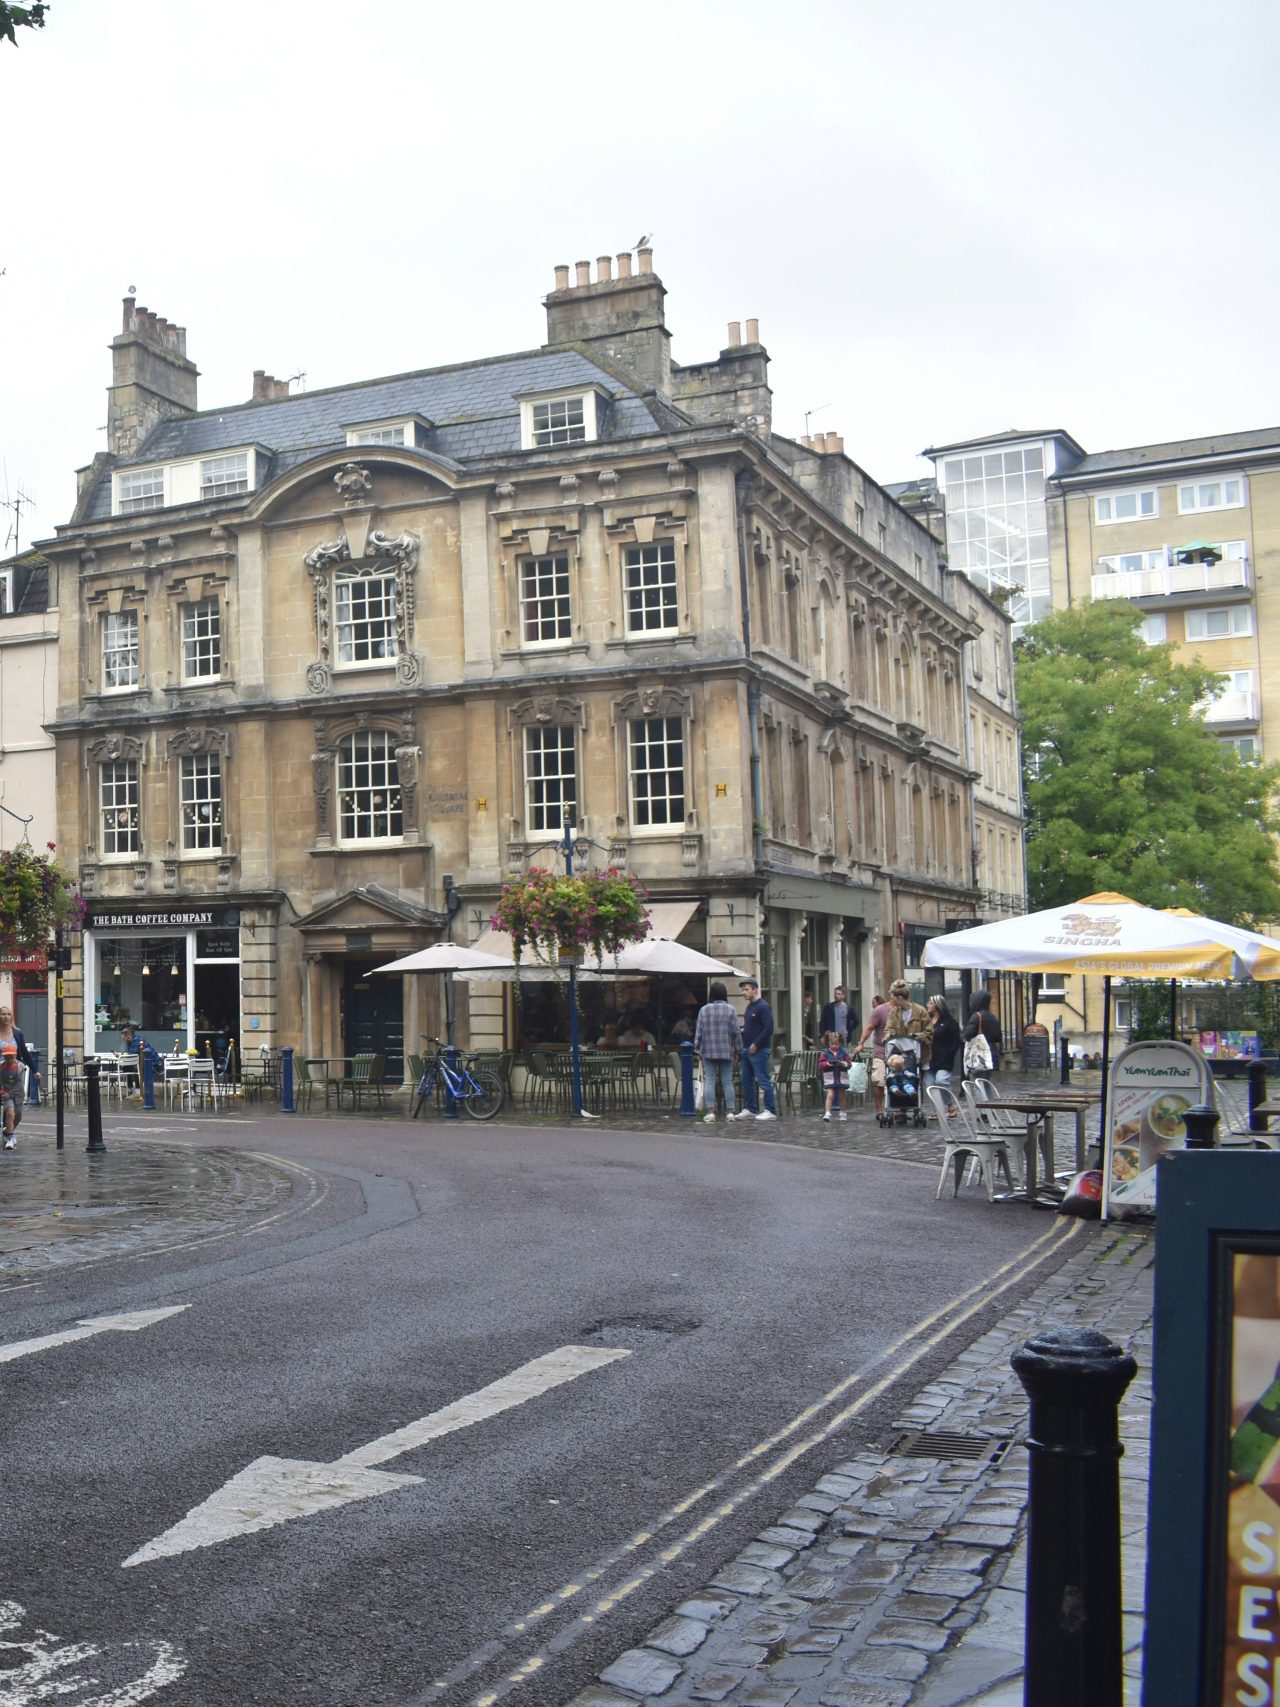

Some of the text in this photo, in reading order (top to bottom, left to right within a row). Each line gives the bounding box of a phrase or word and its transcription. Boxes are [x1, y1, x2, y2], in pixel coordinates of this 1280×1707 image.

[93, 916, 110, 925] THE
[111, 915, 133, 924] BATH
[170, 912, 213, 923] COMPANY
[1043, 936, 1121, 946] SINGHA
[1074, 961, 1106, 971] ASIA'S
[1109, 961, 1144, 971] GLOBAL
[1148, 961, 1195, 971] PREMIUM
